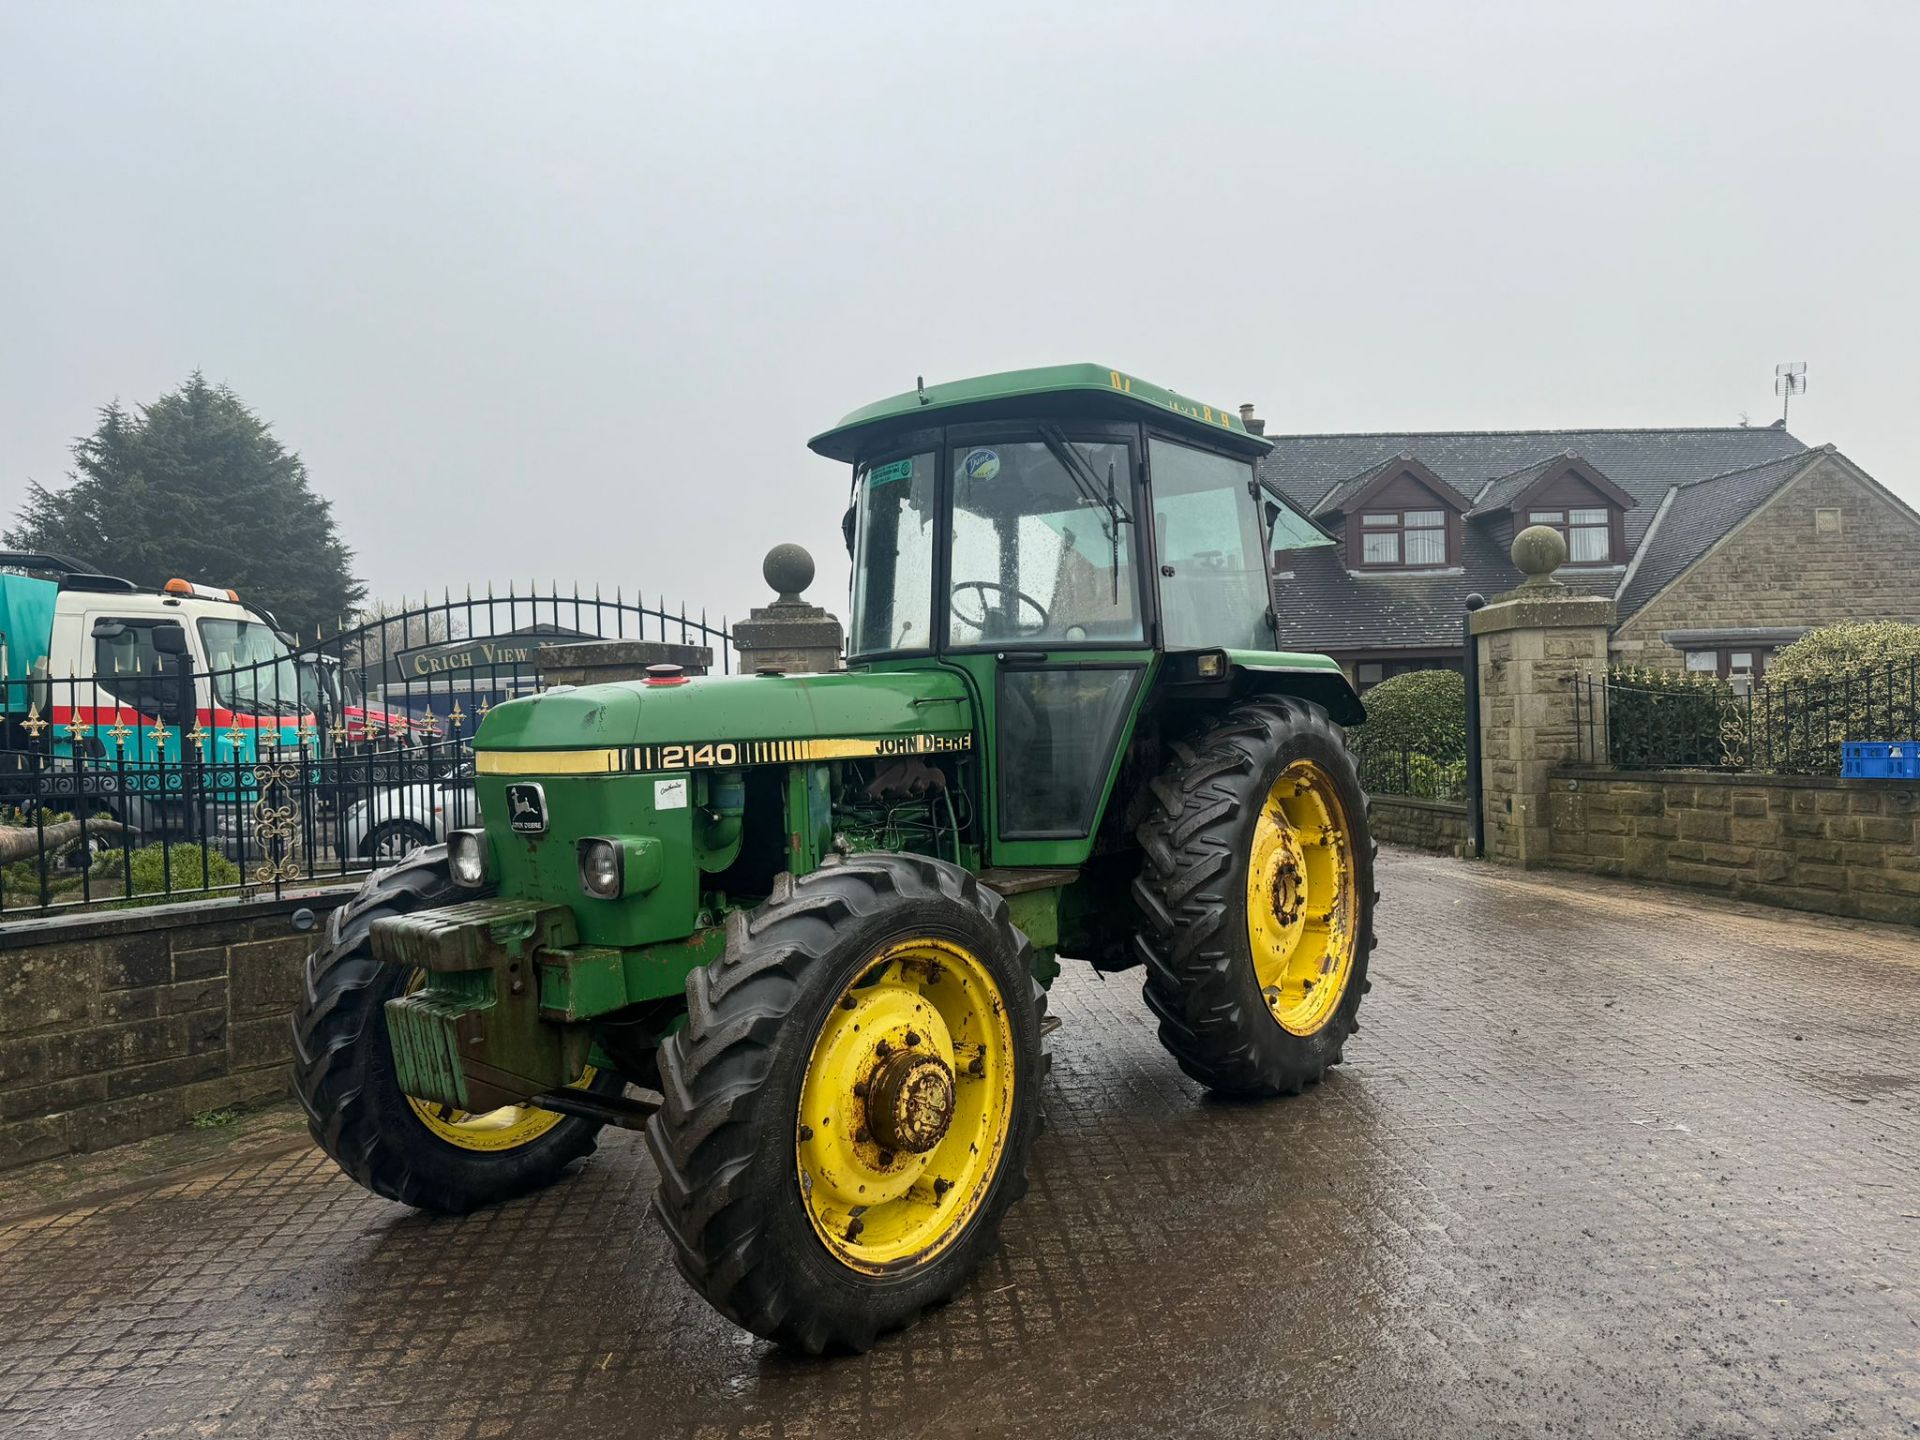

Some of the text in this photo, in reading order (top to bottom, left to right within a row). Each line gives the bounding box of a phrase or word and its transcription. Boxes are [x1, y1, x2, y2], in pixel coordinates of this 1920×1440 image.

[414, 652, 472, 675] CRICH
[480, 643, 528, 664] VIEW
[662, 743, 737, 769] 2140
[875, 736, 915, 755] JOHN
